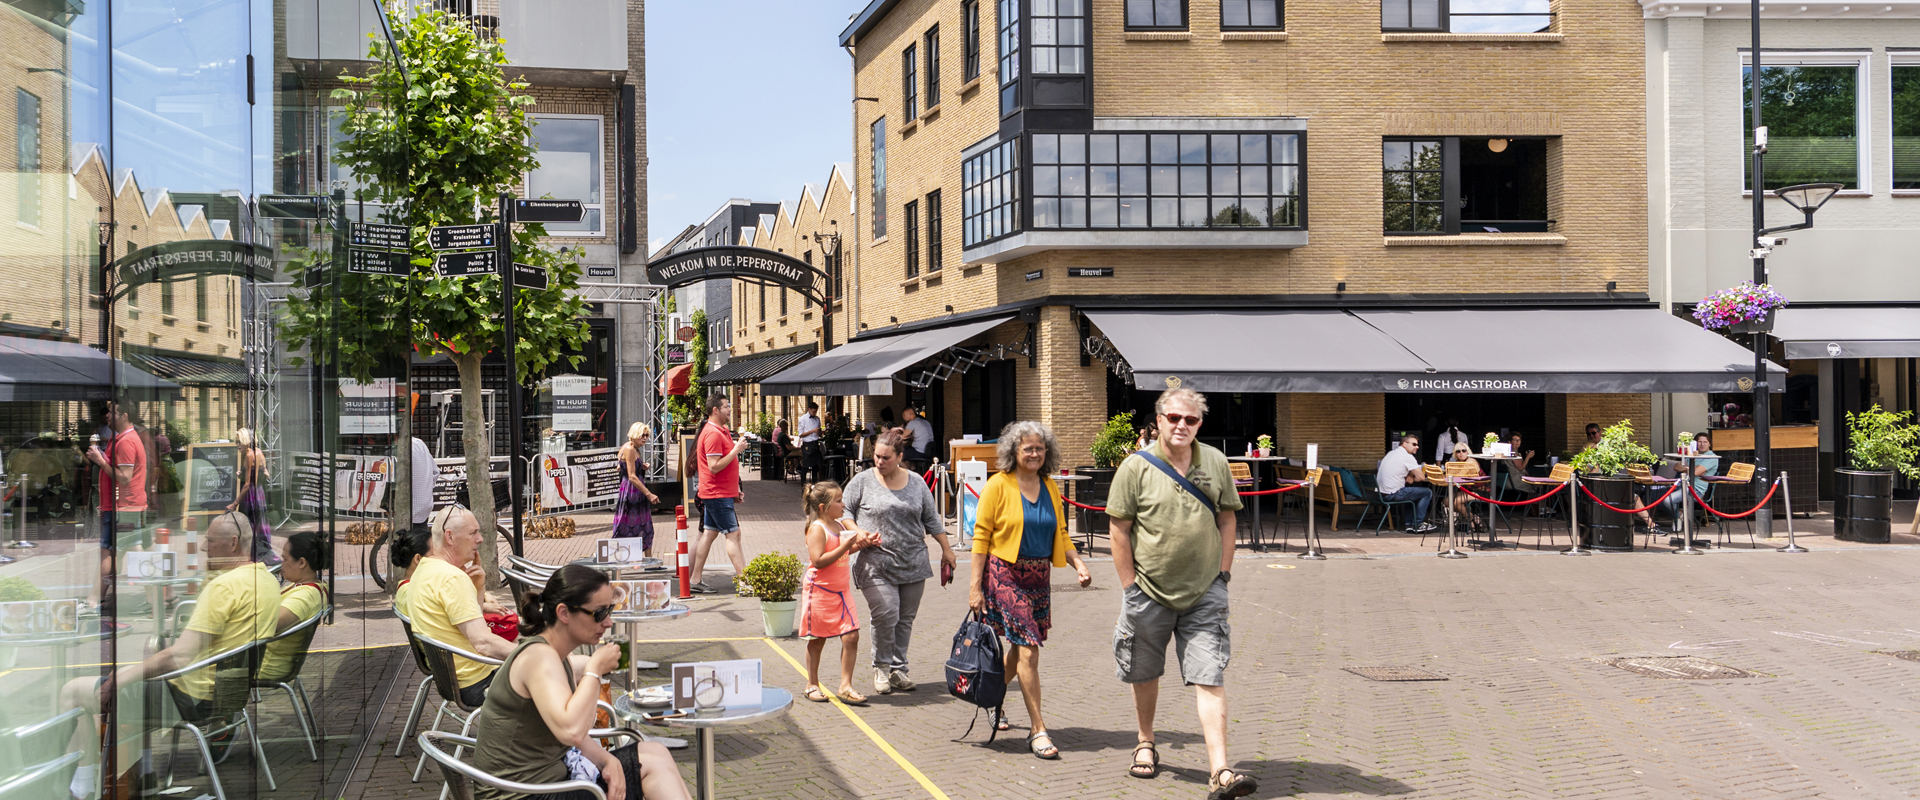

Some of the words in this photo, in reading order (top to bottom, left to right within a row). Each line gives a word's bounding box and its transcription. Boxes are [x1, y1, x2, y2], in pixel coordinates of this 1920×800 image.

[659, 257, 704, 280] WELKOM
[706, 256, 717, 266] IN
[736, 256, 803, 281] PEPERSTRAAT
[1413, 380, 1450, 388] FINCH
[1453, 380, 1527, 389] GASTROBAR
[550, 469, 566, 477] PEPER
